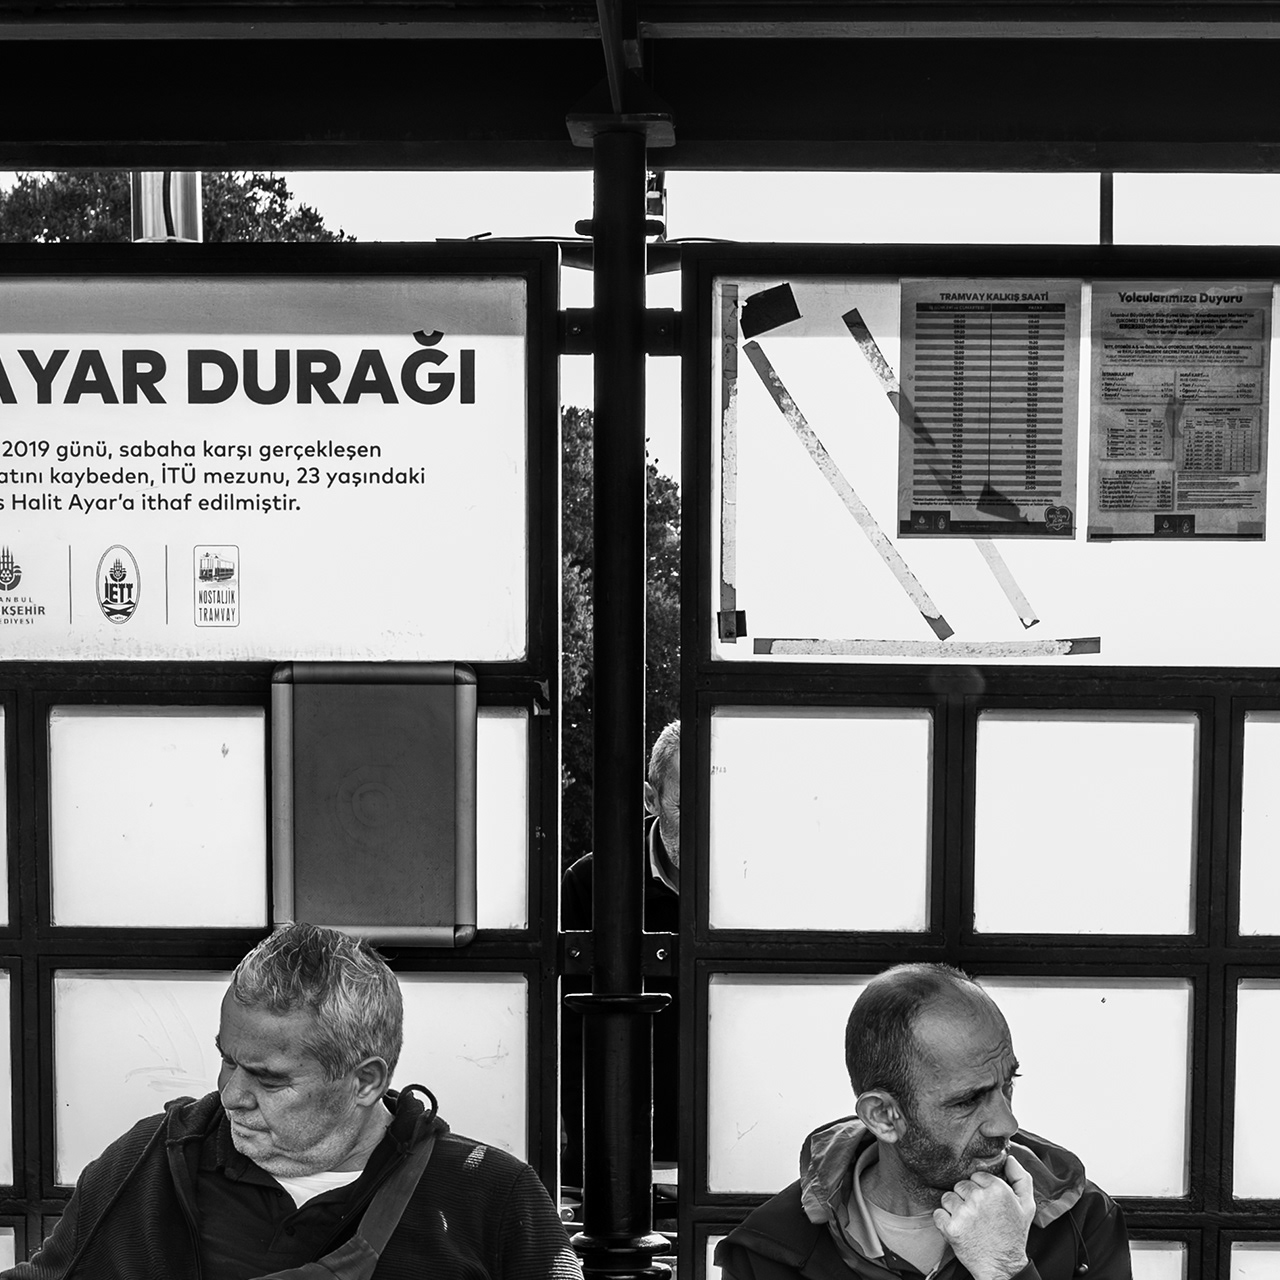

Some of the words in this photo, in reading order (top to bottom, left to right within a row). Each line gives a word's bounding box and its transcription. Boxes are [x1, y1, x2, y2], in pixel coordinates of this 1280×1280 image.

[939, 292, 985, 301] TRAMVAY
[986, 292, 1020, 302] KALKIŞ
[1021, 291, 1049, 301] SAATİ
[1118, 291, 1197, 304] Yolcularımıza
[1200, 292, 1243, 305] Duyuru
[187, 329, 476, 405] DURAĞI
[2, 440, 50, 458] 2019
[56, 440, 113, 462] günü,
[119, 439, 196, 458] sabaha
[203, 439, 252, 461] karşı
[259, 440, 381, 462] gerçekleşen
[50, 466, 154, 489] kaybeden,
[161, 463, 196, 484] İTÜ
[204, 471, 290, 487] mezunu,
[296, 467, 320, 484] 23
[326, 467, 425, 489] yaşındaki
[12, 493, 63, 511] Halit
[141, 493, 192, 511] ithaf
[198, 493, 301, 514] edilmiştir.
[198, 588, 236, 605] NOSTALJİK
[198, 607, 236, 622] TRAMVAY
